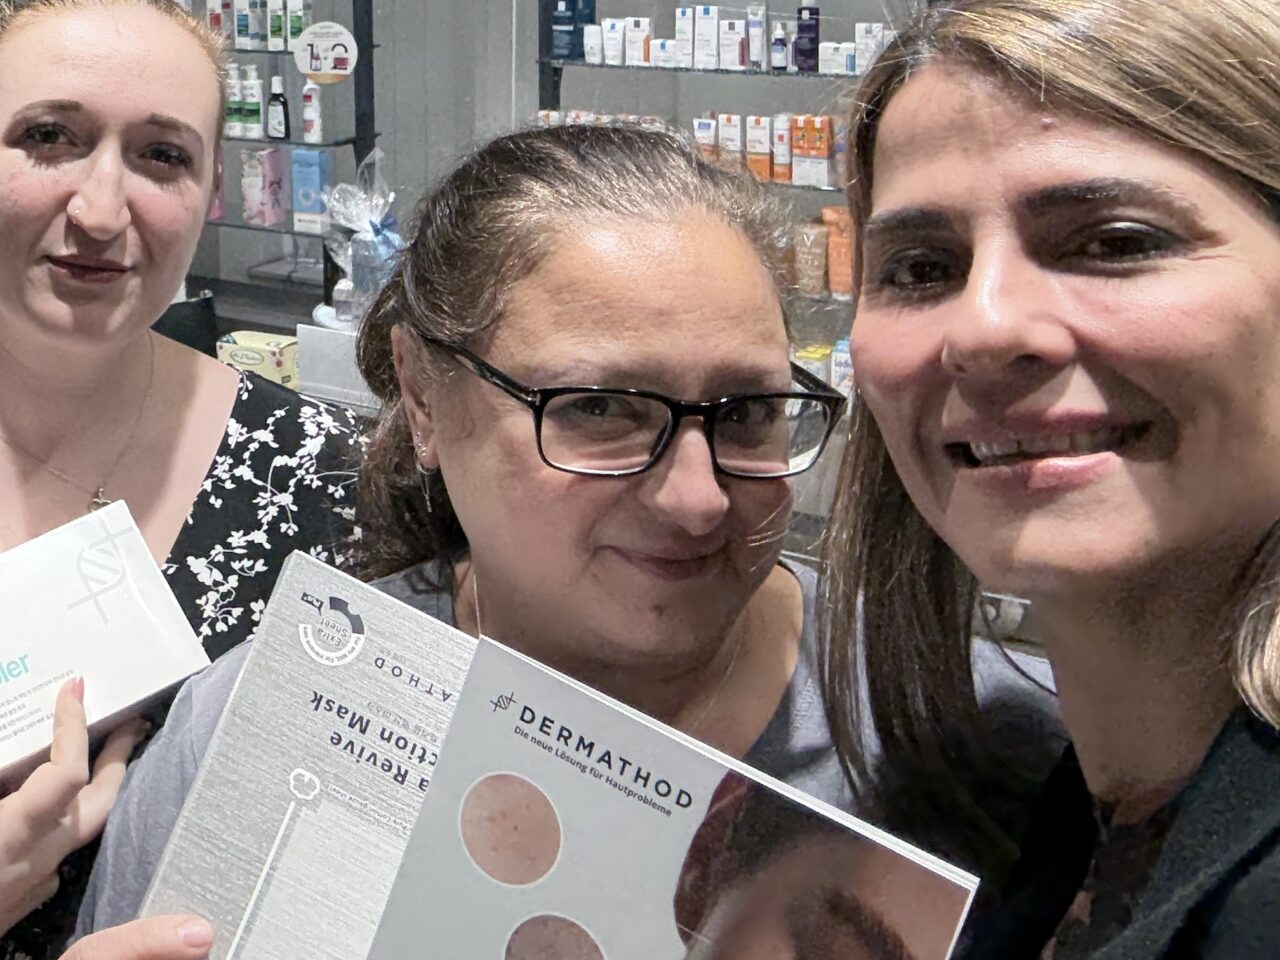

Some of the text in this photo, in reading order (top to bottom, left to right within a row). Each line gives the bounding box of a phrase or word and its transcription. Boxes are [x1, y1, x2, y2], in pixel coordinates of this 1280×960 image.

[317, 628, 342, 647] Extra
[374, 656, 453, 702] ATHOD
[310, 690, 371, 735] Mask
[330, 731, 409, 785] Revive
[380, 726, 438, 767] ction
[519, 705, 692, 809] DERMATHOD
[514, 725, 672, 816] Die neue Lösung für Hautprobleme
